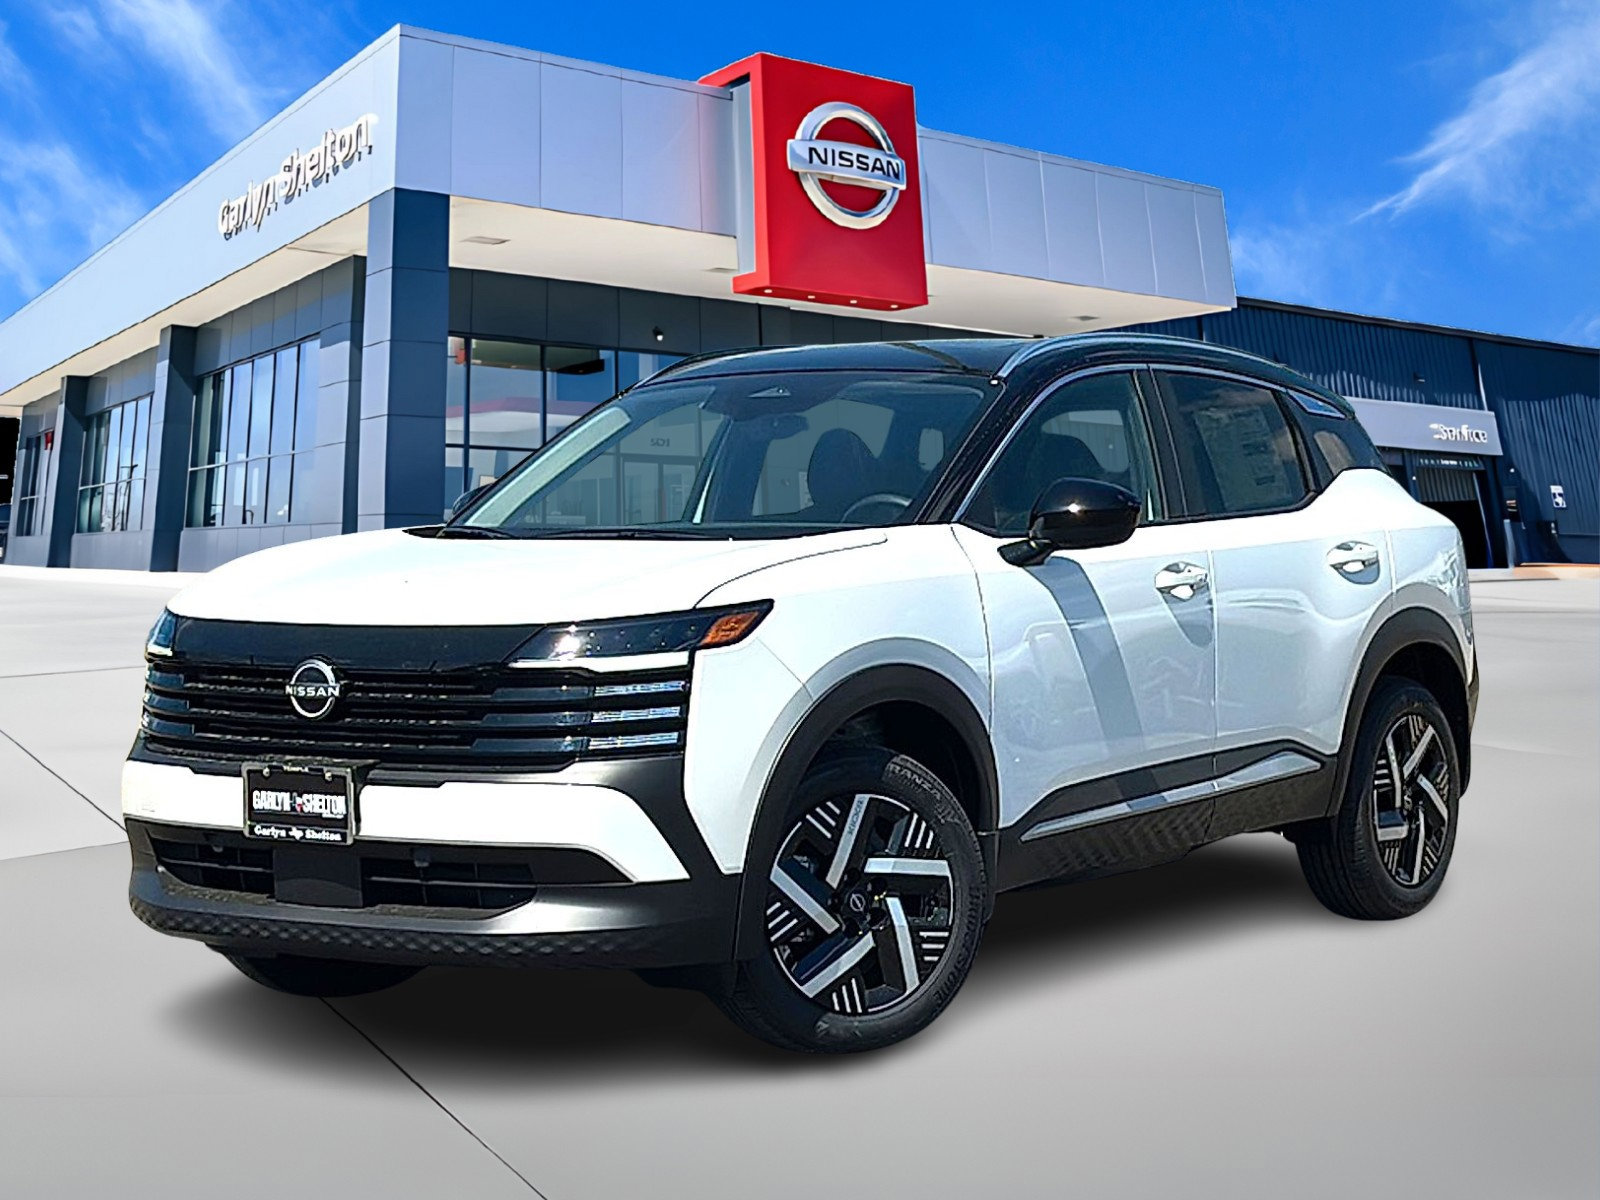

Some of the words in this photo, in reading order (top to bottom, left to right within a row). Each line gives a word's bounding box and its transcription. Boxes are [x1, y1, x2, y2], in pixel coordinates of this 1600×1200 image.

[808, 147, 900, 180] NISSAN
[285, 685, 340, 697] NISSAN
[888, 762, 941, 801] RANZA
[252, 790, 291, 811] GARLYN
[302, 793, 347, 815] SHELTON
